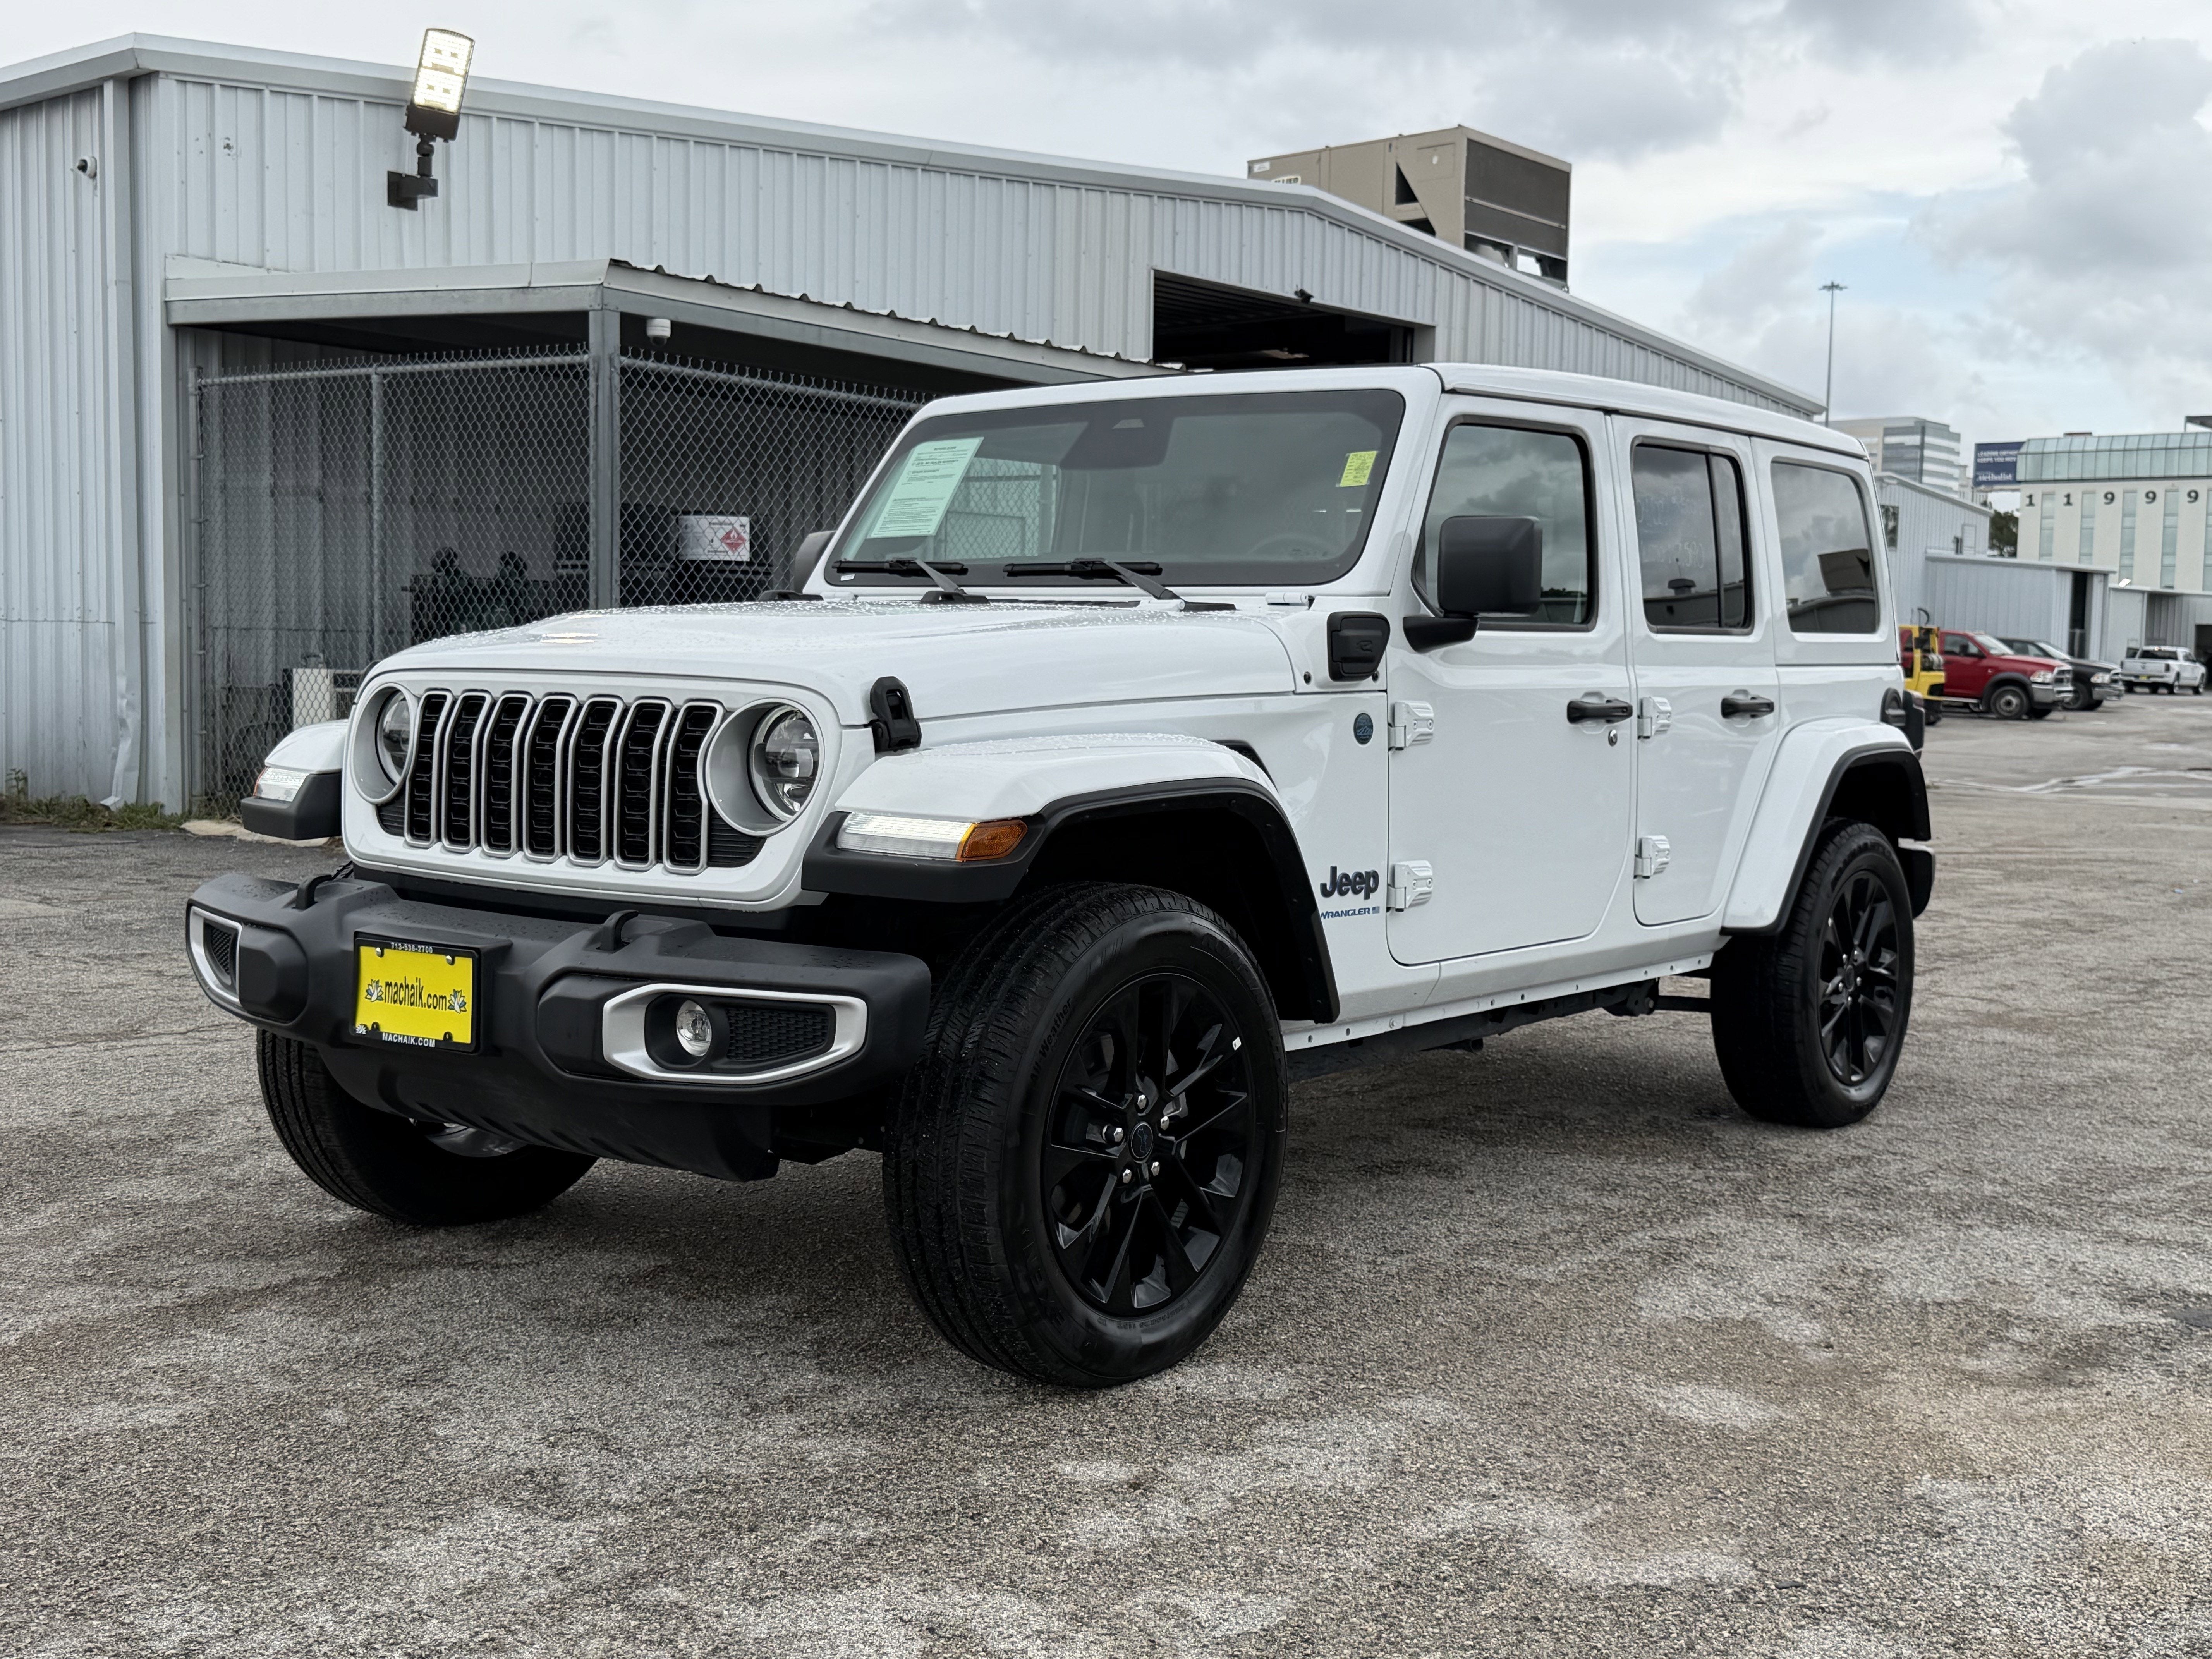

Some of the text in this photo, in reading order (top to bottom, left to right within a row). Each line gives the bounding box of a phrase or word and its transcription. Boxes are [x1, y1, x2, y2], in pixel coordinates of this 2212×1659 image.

[1320, 866, 1379, 900] Jeep
[1321, 907, 1370, 919] WRANGLER
[384, 975, 447, 1011] machaik.com
[382, 1032, 435, 1047] MACHAIK.COM
